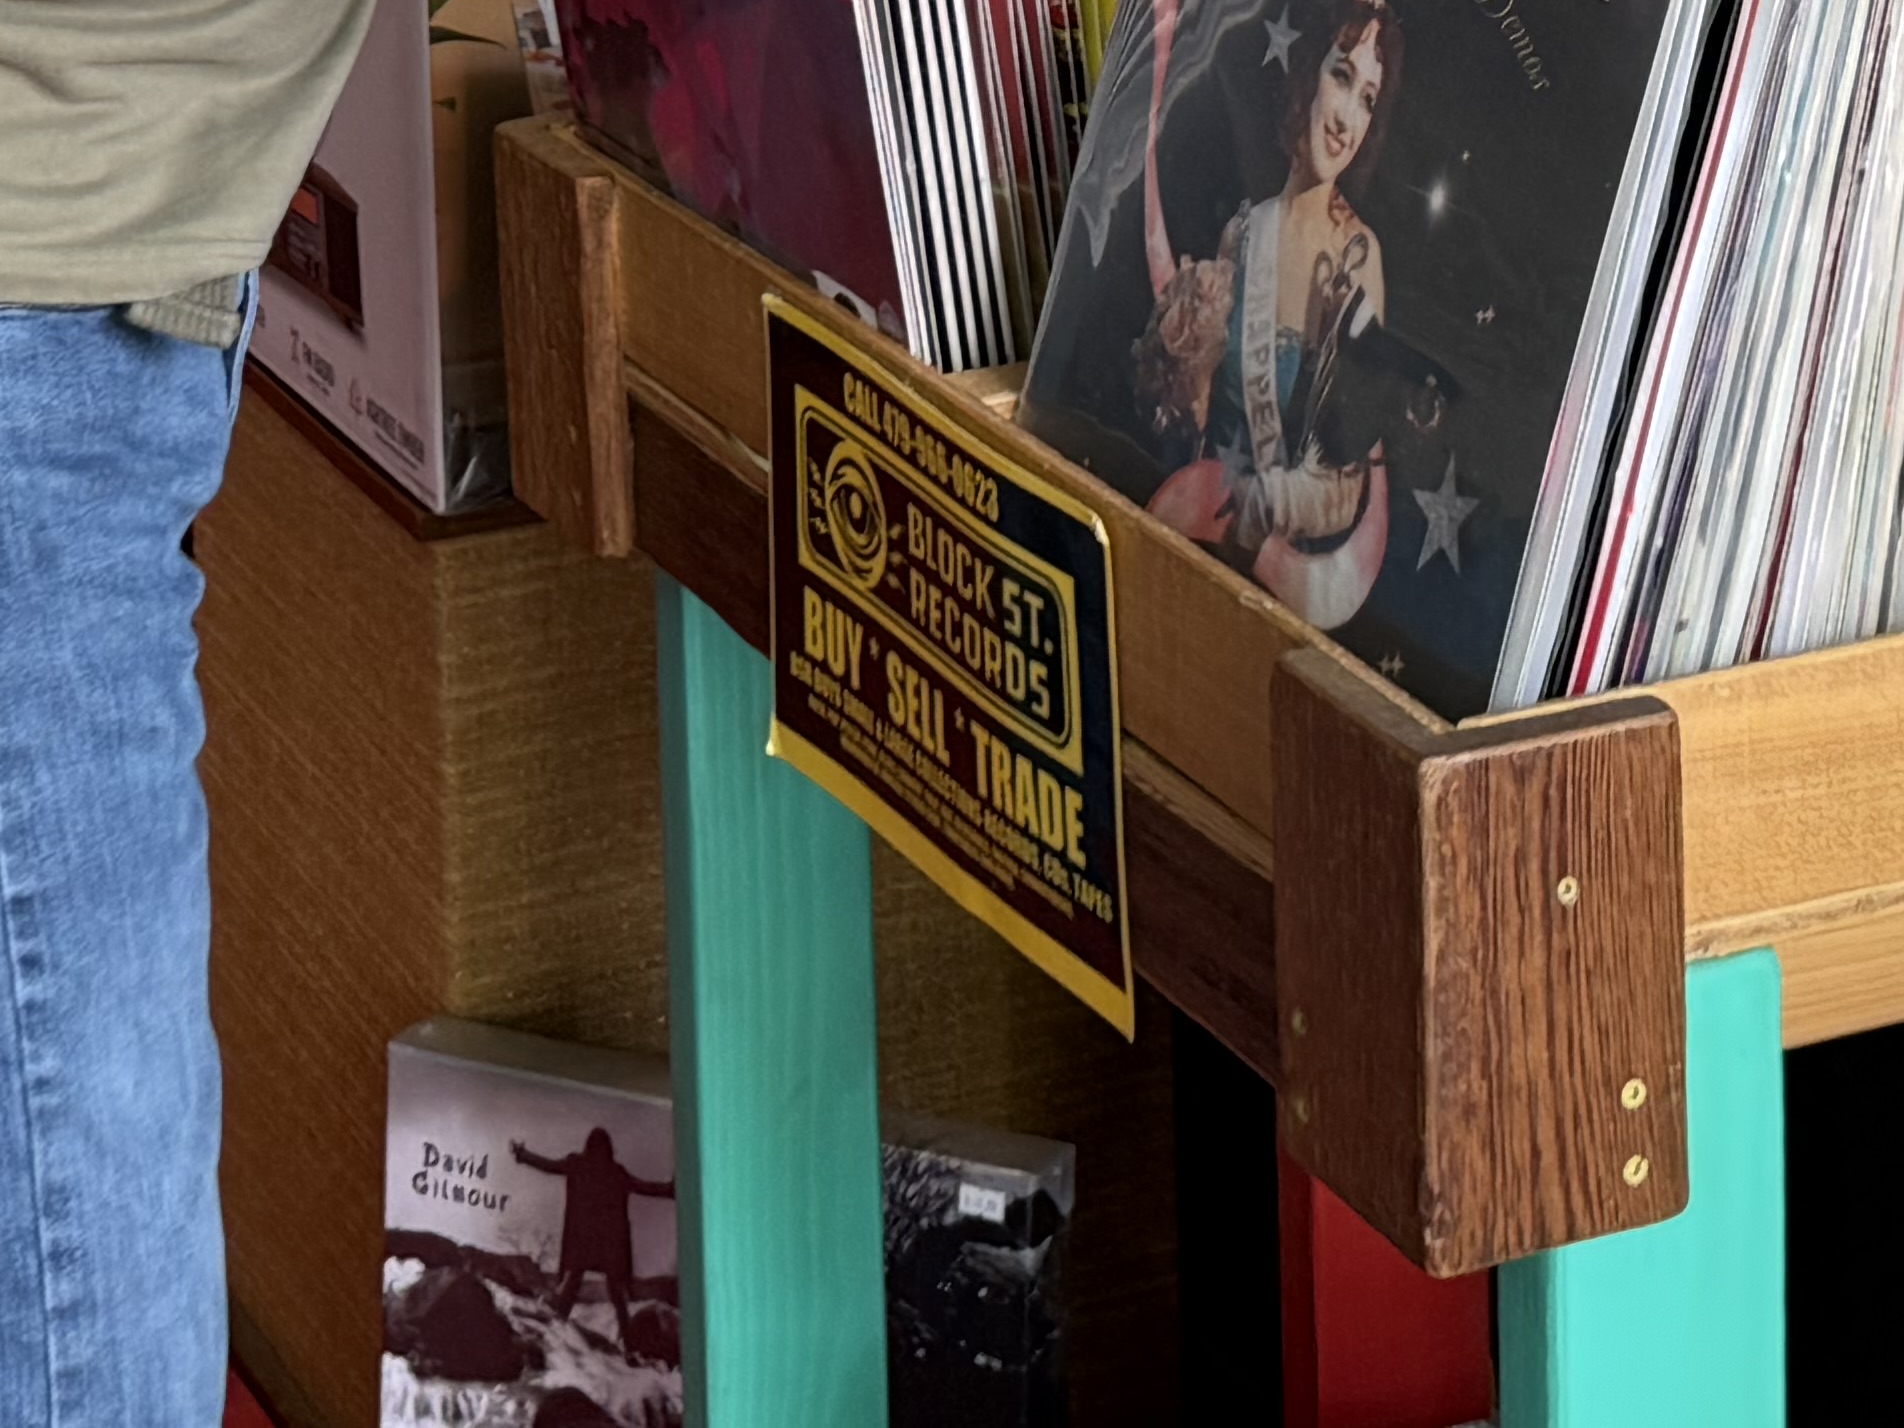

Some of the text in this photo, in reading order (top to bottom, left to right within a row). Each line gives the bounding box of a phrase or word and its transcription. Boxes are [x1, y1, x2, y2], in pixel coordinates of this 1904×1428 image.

[843, 371, 880, 438] CALL
[906, 501, 1054, 656] BLOCK ST.
[909, 567, 1050, 721] RECORDS
[802, 585, 1088, 873] BUY SELL TRADE
[411, 1168, 512, 1214] Gilmour
[422, 1140, 490, 1181] David
